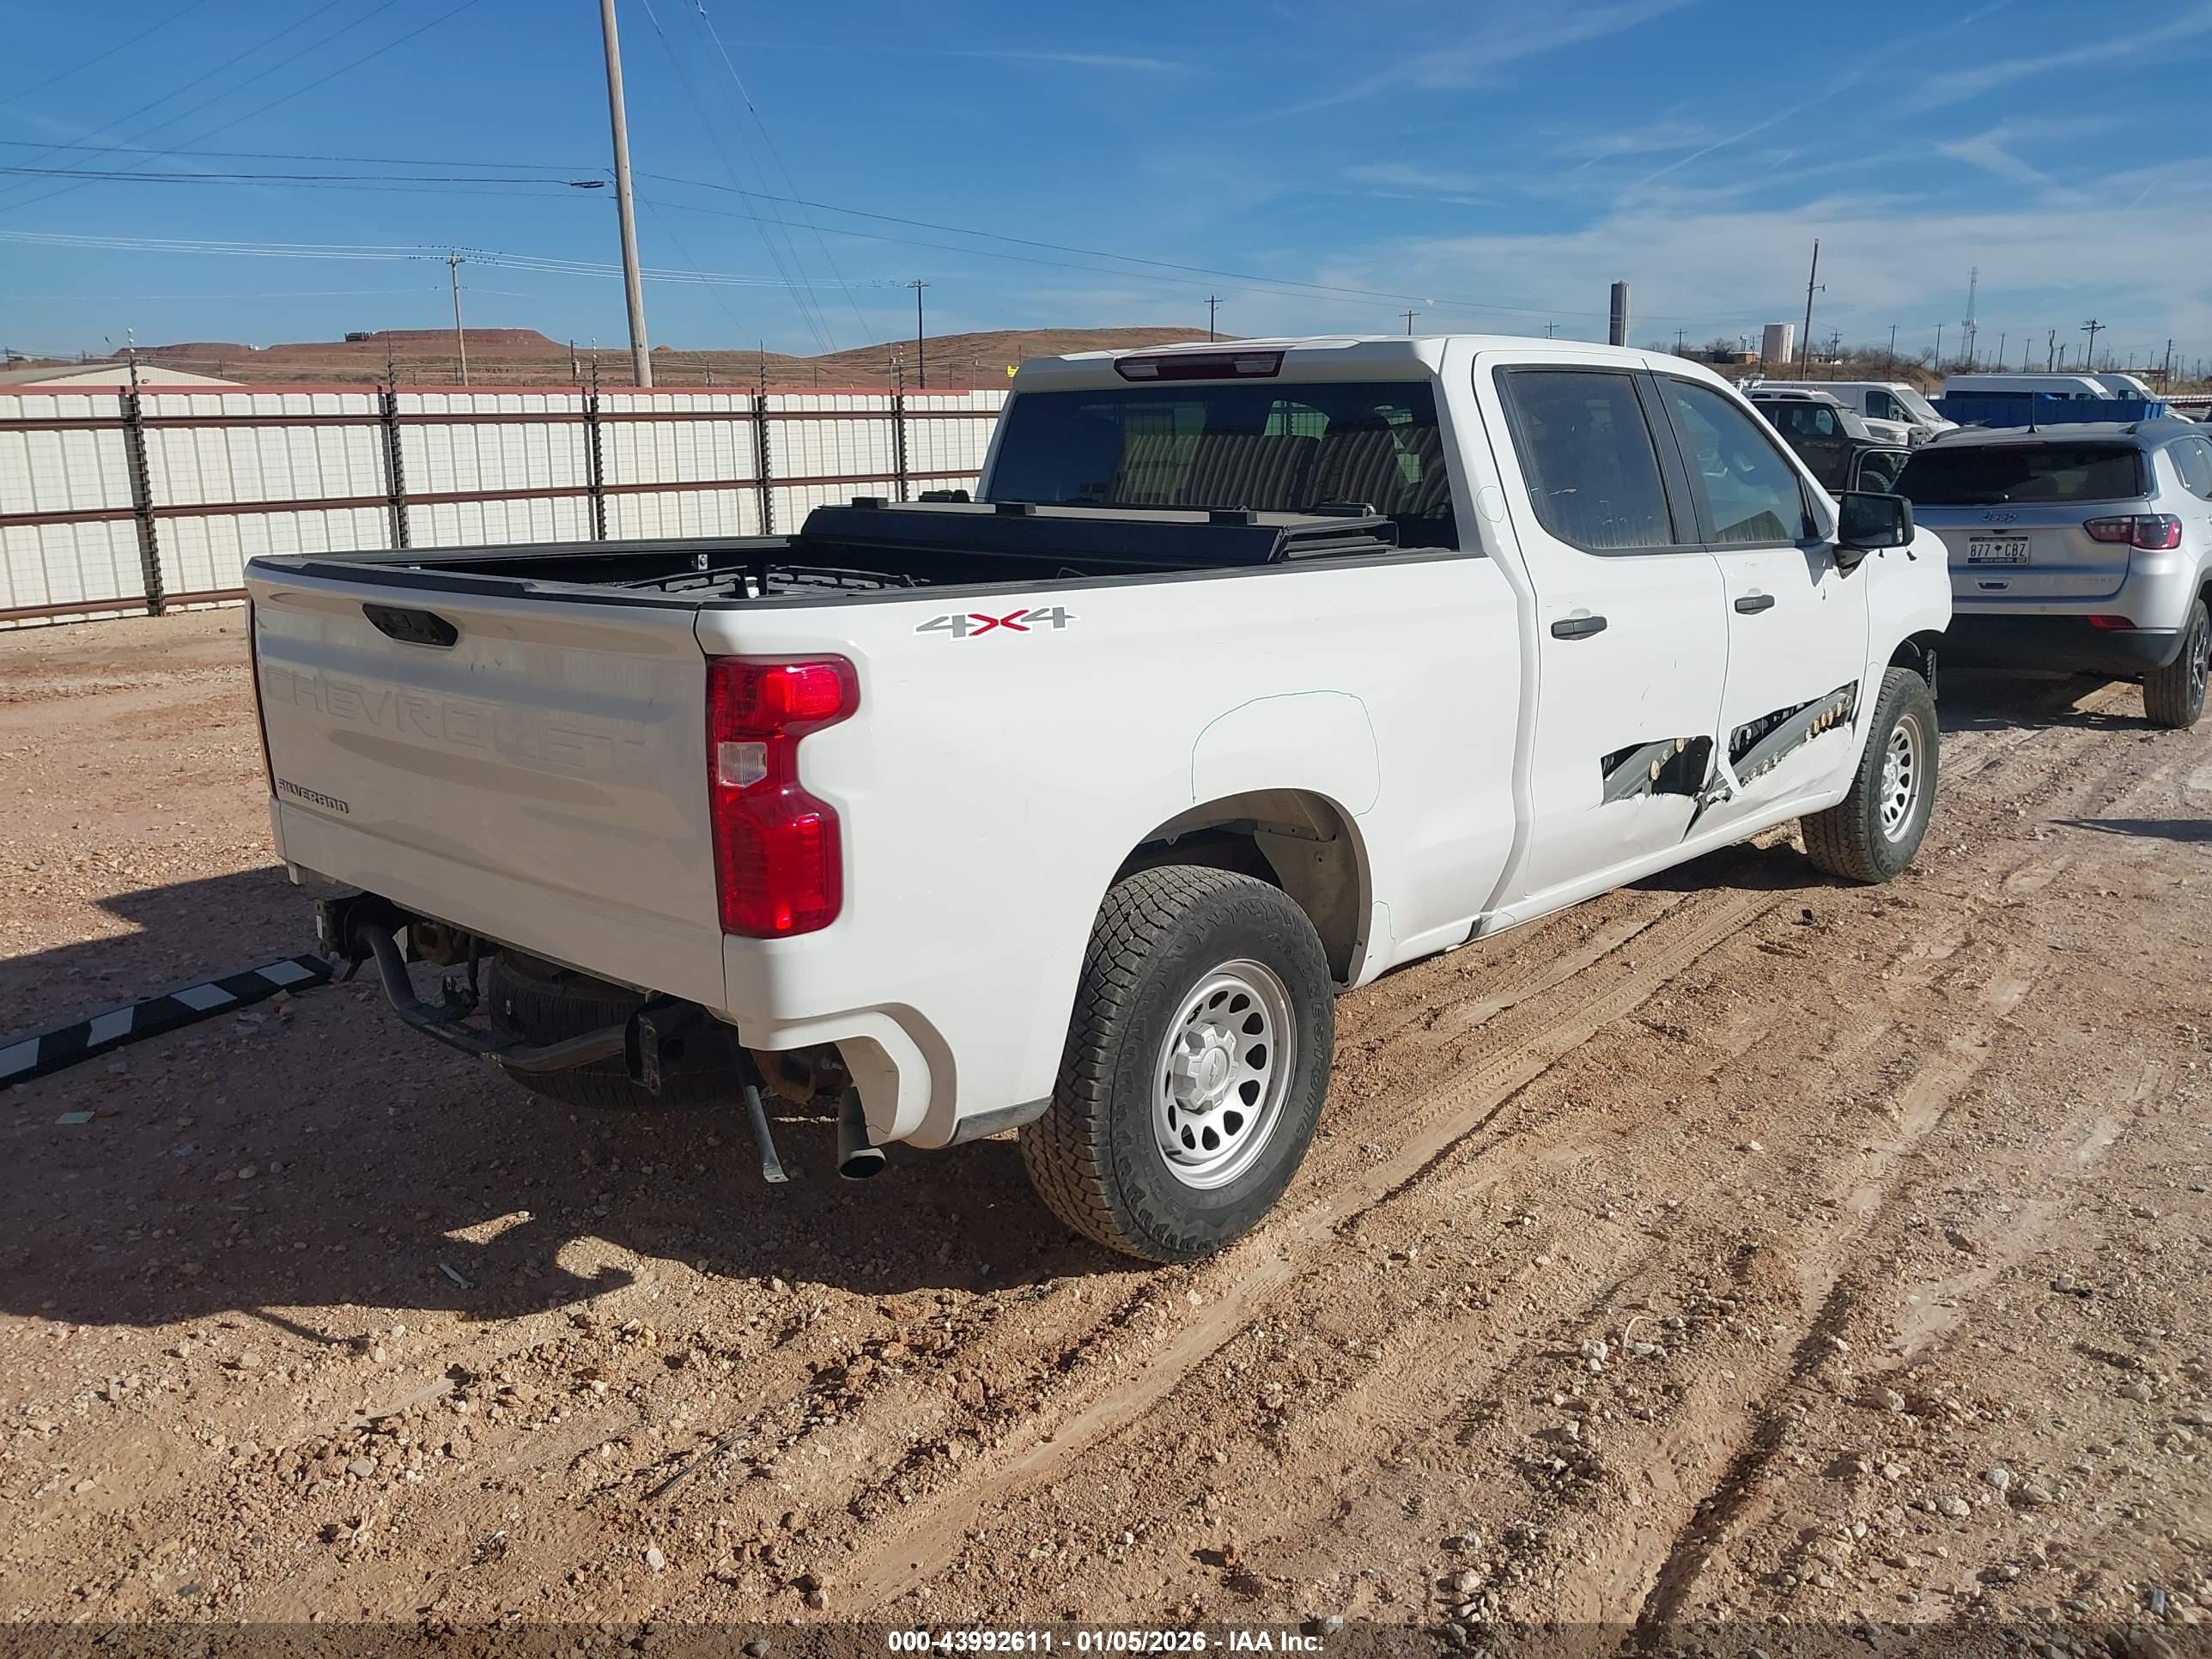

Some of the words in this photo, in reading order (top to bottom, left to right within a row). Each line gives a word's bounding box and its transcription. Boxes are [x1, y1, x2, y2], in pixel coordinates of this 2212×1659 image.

[1970, 544, 1991, 557] 877
[2004, 543, 2026, 556] CBZ
[277, 777, 349, 814] SILVERADO
